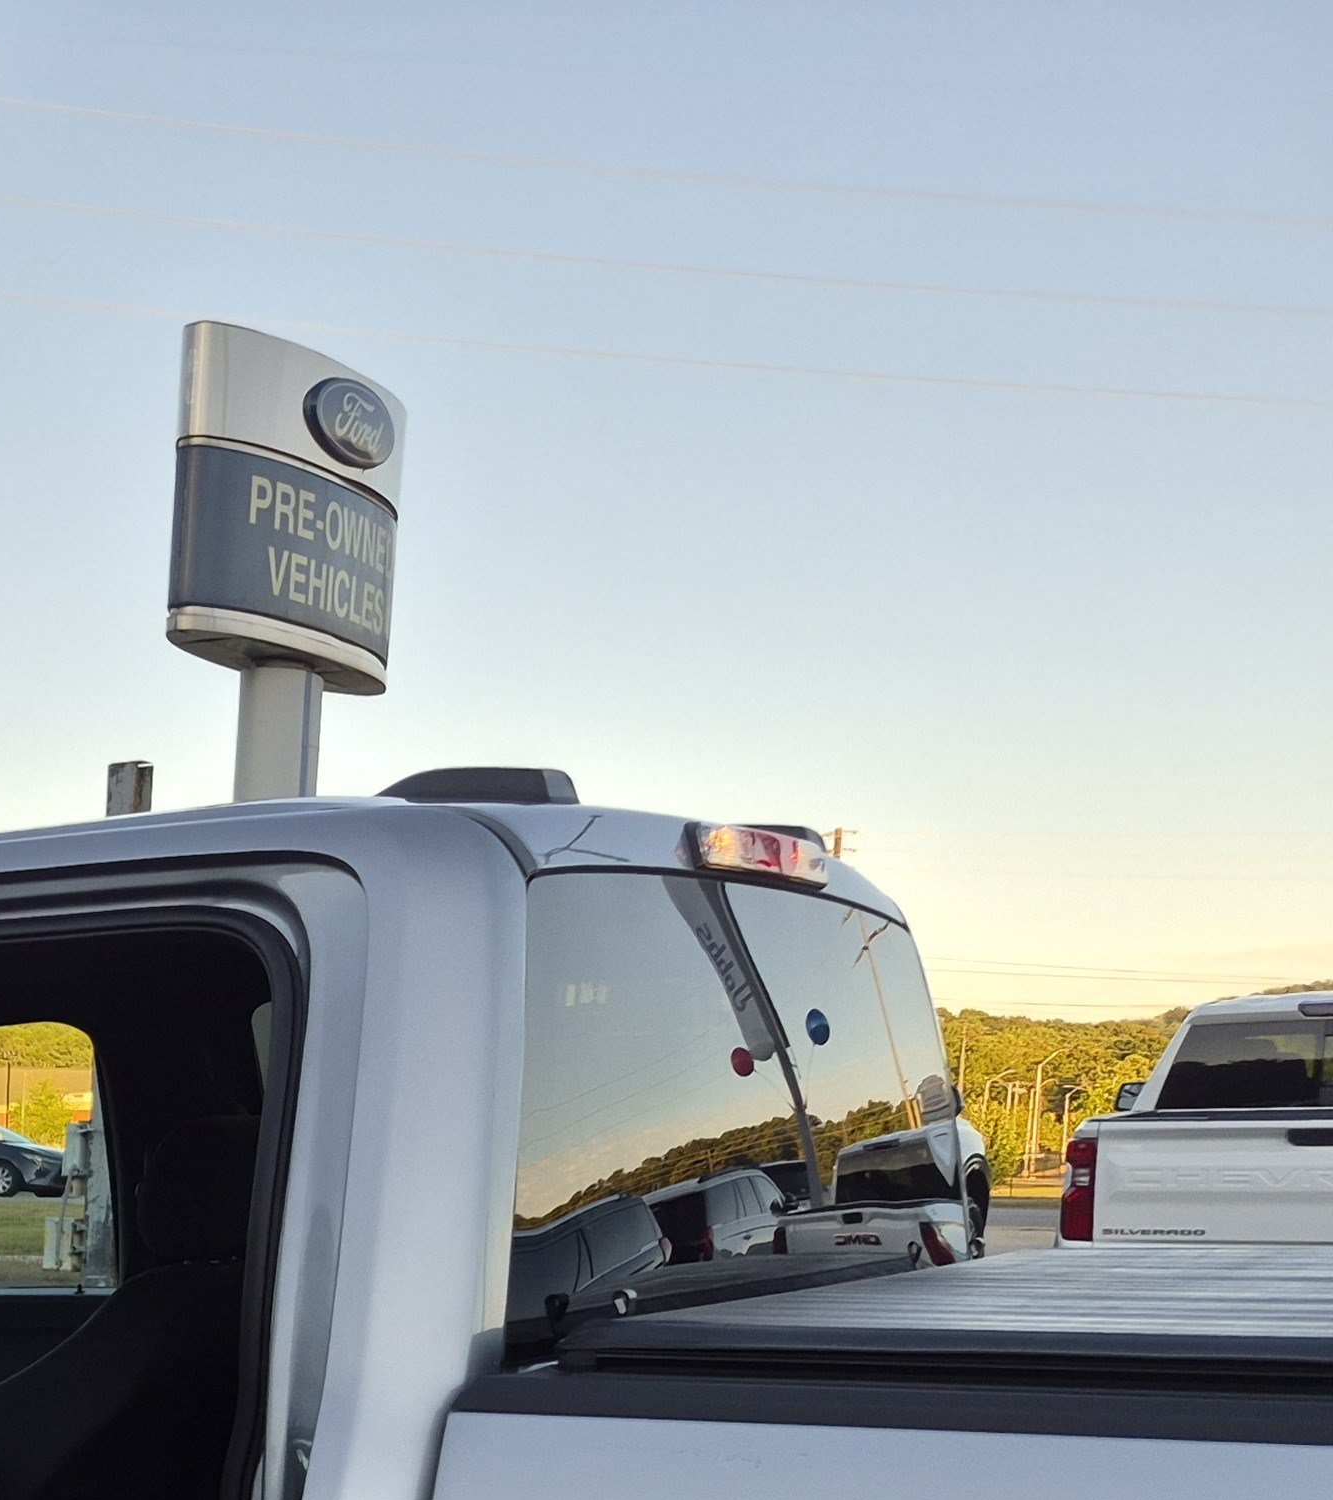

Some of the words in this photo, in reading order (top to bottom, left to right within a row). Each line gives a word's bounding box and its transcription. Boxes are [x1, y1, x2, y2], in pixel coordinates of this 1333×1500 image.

[335, 391, 385, 454] Ford
[267, 545, 385, 637] VEHICLES
[1101, 1227, 1207, 1237] SILVERADO
